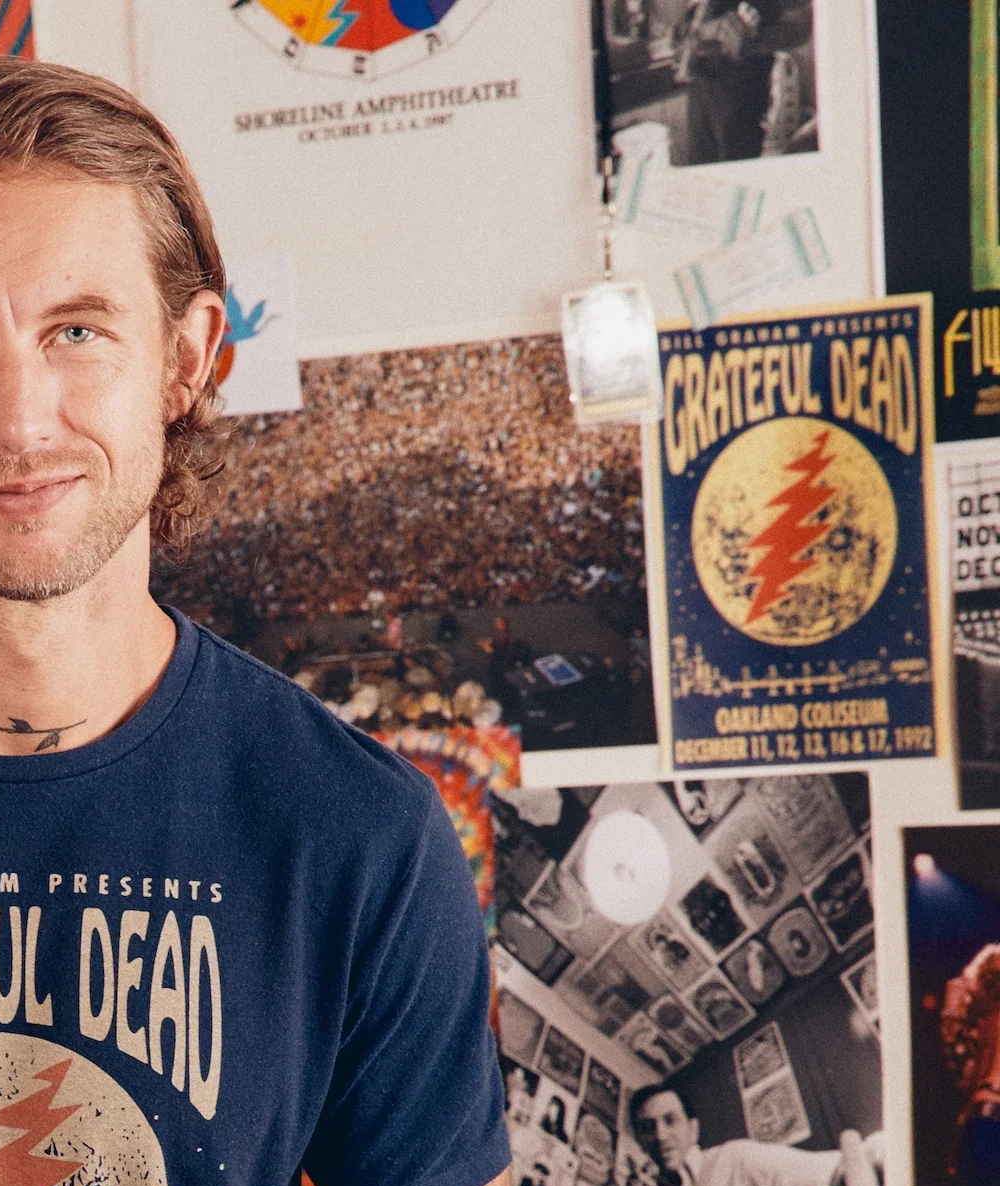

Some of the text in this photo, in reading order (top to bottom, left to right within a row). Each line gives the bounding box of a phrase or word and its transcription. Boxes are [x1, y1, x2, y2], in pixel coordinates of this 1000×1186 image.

[235, 78, 520, 133] SHORELINE AMPHITHEATRE
[660, 313, 914, 351] BILL GRAHAM PRESENTS
[664, 334, 917, 476] GRATEFUL DEAD
[714, 698, 889, 734] OAKLAND COLISEUM
[674, 736, 748, 764] DECEMBER
[776, 733, 800, 761] 12,
[895, 726, 932, 751] 1992
[48, 873, 223, 903] PRESENTS
[78, 907, 223, 1121] DEAD
